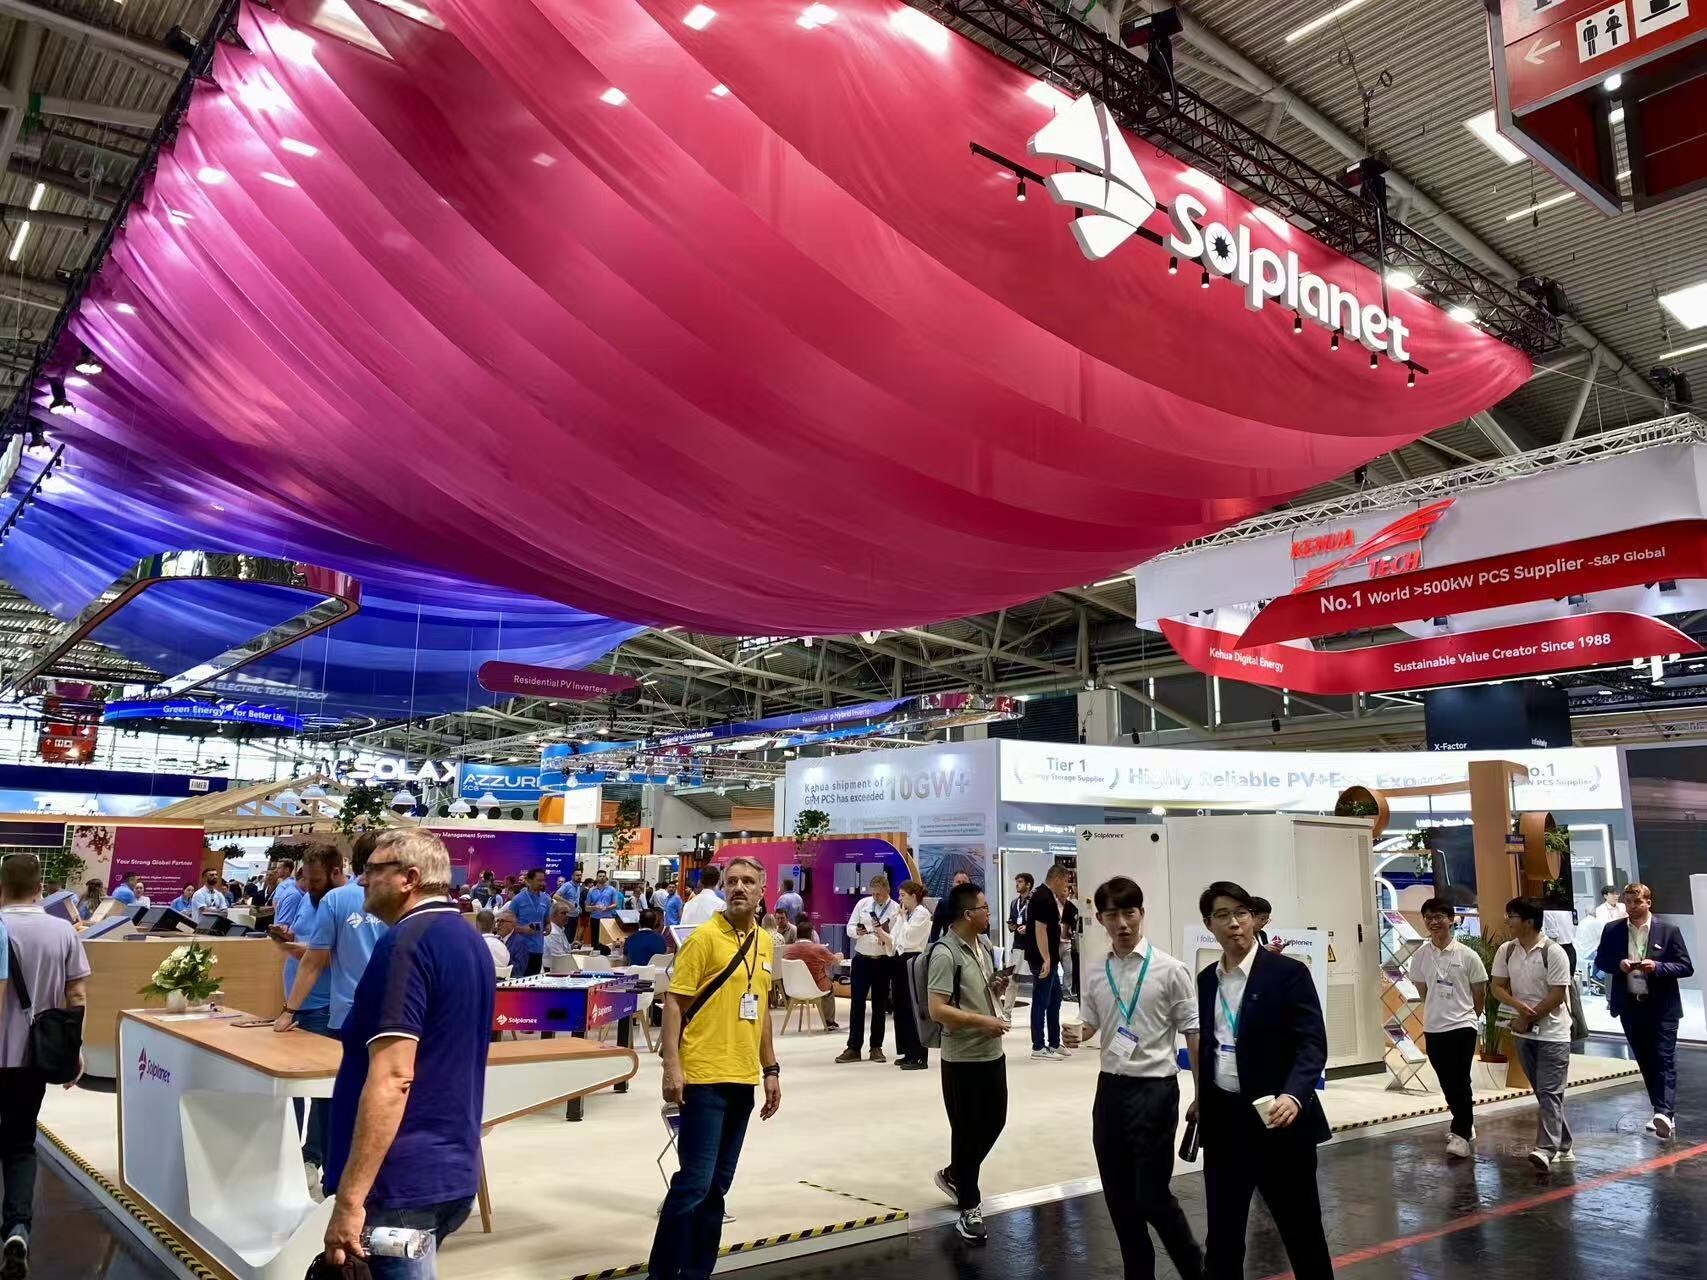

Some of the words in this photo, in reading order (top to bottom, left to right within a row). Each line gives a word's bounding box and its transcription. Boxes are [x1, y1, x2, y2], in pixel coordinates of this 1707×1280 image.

[1163, 193, 1410, 362] Solplanet
[1291, 528, 1355, 559] KEHUA
[1368, 550, 1421, 578] TECH
[1320, 590, 1362, 614] No.1
[1368, 586, 1410, 605] World
[1413, 574, 1474, 596] >500kW
[1478, 568, 1510, 586] PCS
[1514, 557, 1585, 580] Supplier
[1624, 547, 1666, 562] Global
[1209, 647, 1233, 661] Kehua
[1234, 652, 1258, 667] Digital
[1259, 657, 1284, 673] Energy
[1393, 655, 1456, 673] Sustainable
[1457, 652, 1489, 664] Value
[1492, 644, 1538, 659] Creator
[1541, 640, 1575, 653] Since
[1578, 633, 1611, 648] 1988
[216, 682, 264, 694] ELECTRIC
[265, 686, 329, 700] TECHNOLOGY
[513, 674, 560, 688] Residential
[560, 679, 572, 689] PV
[572, 681, 608, 694] Inverters
[163, 705, 190, 715] Green
[193, 705, 225, 717] Energy
[233, 708, 246, 717] for
[248, 709, 272, 720] Better
[272, 713, 284, 722] Life
[1433, 742, 1468, 751] X-Factor
[347, 756, 459, 782] SOLAX
[1046, 757, 1074, 772] Tier
[1079, 759, 1086, 773] 1
[1529, 763, 1555, 777] o.1
[832, 779, 871, 792] shipment
[874, 776, 885, 787] of
[887, 769, 968, 801] 10GW+
[821, 793, 835, 804] PCS
[836, 792, 849, 803] has
[849, 790, 885, 803] exceeded
[442, 831, 476, 839] Management
[508, 1017, 538, 1025] Solplanet
[146, 1058, 171, 1084] Solplanet
